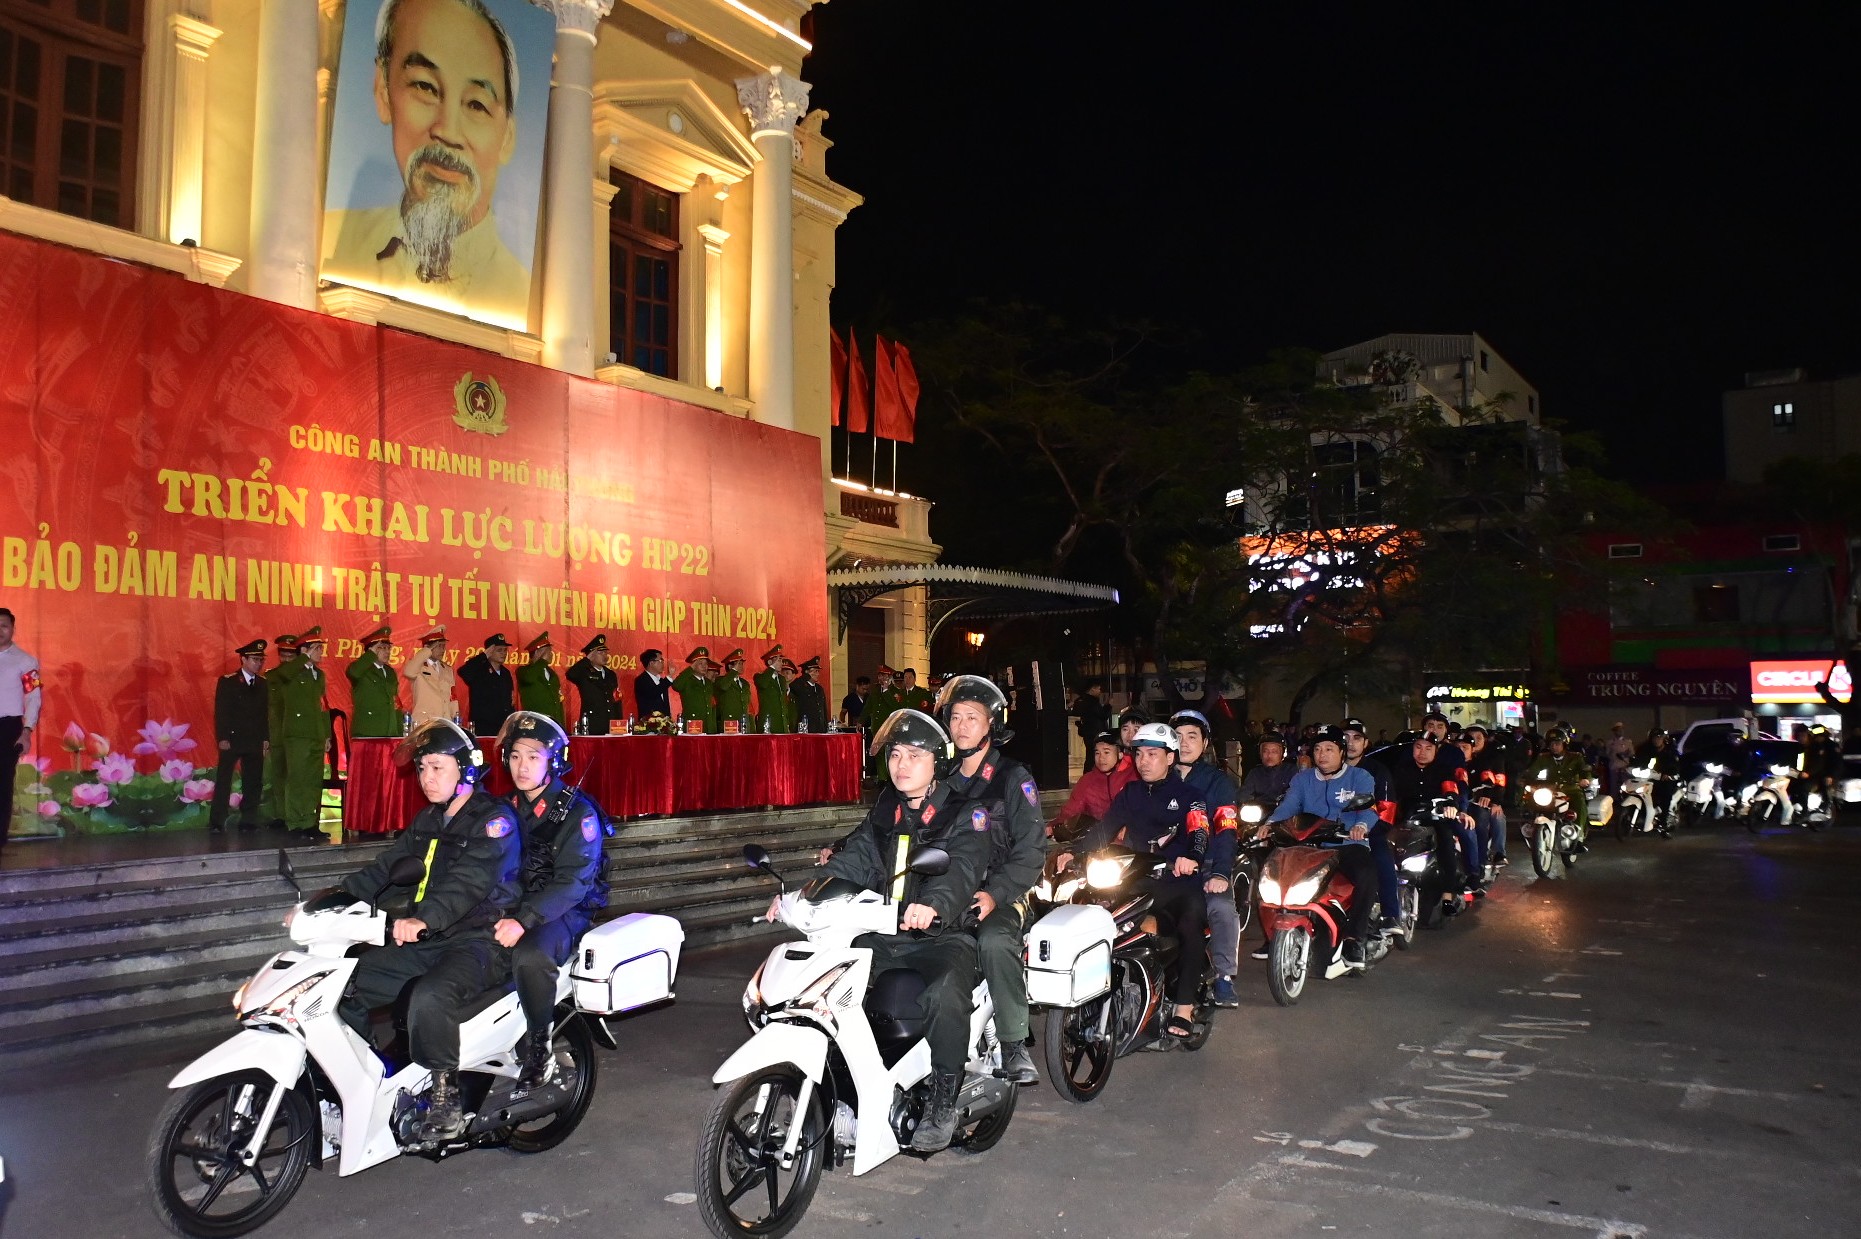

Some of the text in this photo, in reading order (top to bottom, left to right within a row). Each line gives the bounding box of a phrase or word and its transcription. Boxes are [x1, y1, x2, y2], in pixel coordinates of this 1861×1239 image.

[290, 424, 360, 458] CÔNG
[367, 438, 401, 466] AN
[408, 445, 482, 478] THÀNH
[489, 458, 530, 486] PHỐ
[157, 457, 710, 576] TRIỂN KHAI LỰC LƯỢNG HP22
[3, 522, 777, 640] BẢO ĐẢM AN NINH TRẬT TỰ TẾT NGUYÊN ĐÁN GIÁP THÌN 2024
[335, 639, 405, 665] Phg,
[1587, 672, 1639, 681] COFFEE
[1588, 680, 1738, 697] TRUNG NGUYÊN
